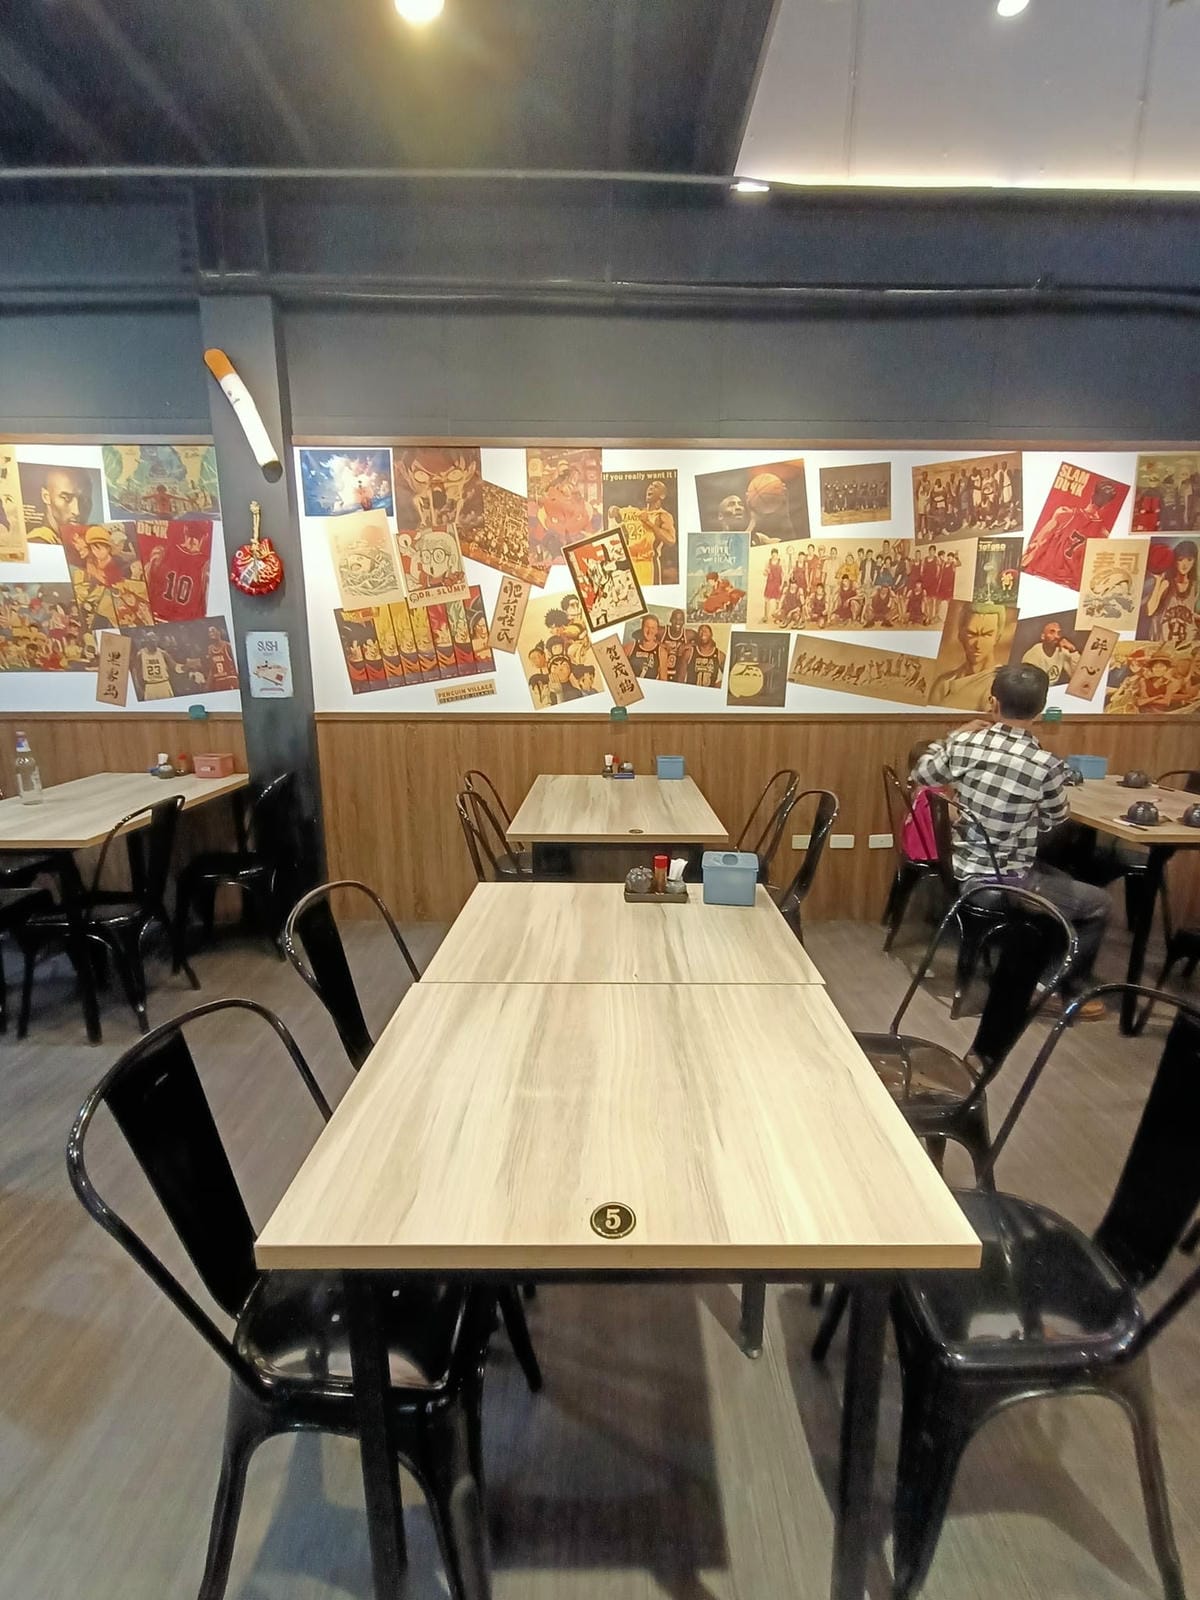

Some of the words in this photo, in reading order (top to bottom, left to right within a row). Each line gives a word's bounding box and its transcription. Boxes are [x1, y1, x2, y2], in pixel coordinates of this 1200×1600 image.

[610, 474, 623, 482] you
[625, 472, 645, 481] really
[647, 472, 665, 480] want
[1060, 464, 1090, 483] SLAM
[1064, 529, 1086, 560] 7
[163, 570, 194, 606] 10
[419, 588, 434, 599] DR.
[437, 584, 466, 596] SLUMP
[147, 665, 161, 676] 23
[605, 1208, 621, 1230] 5
